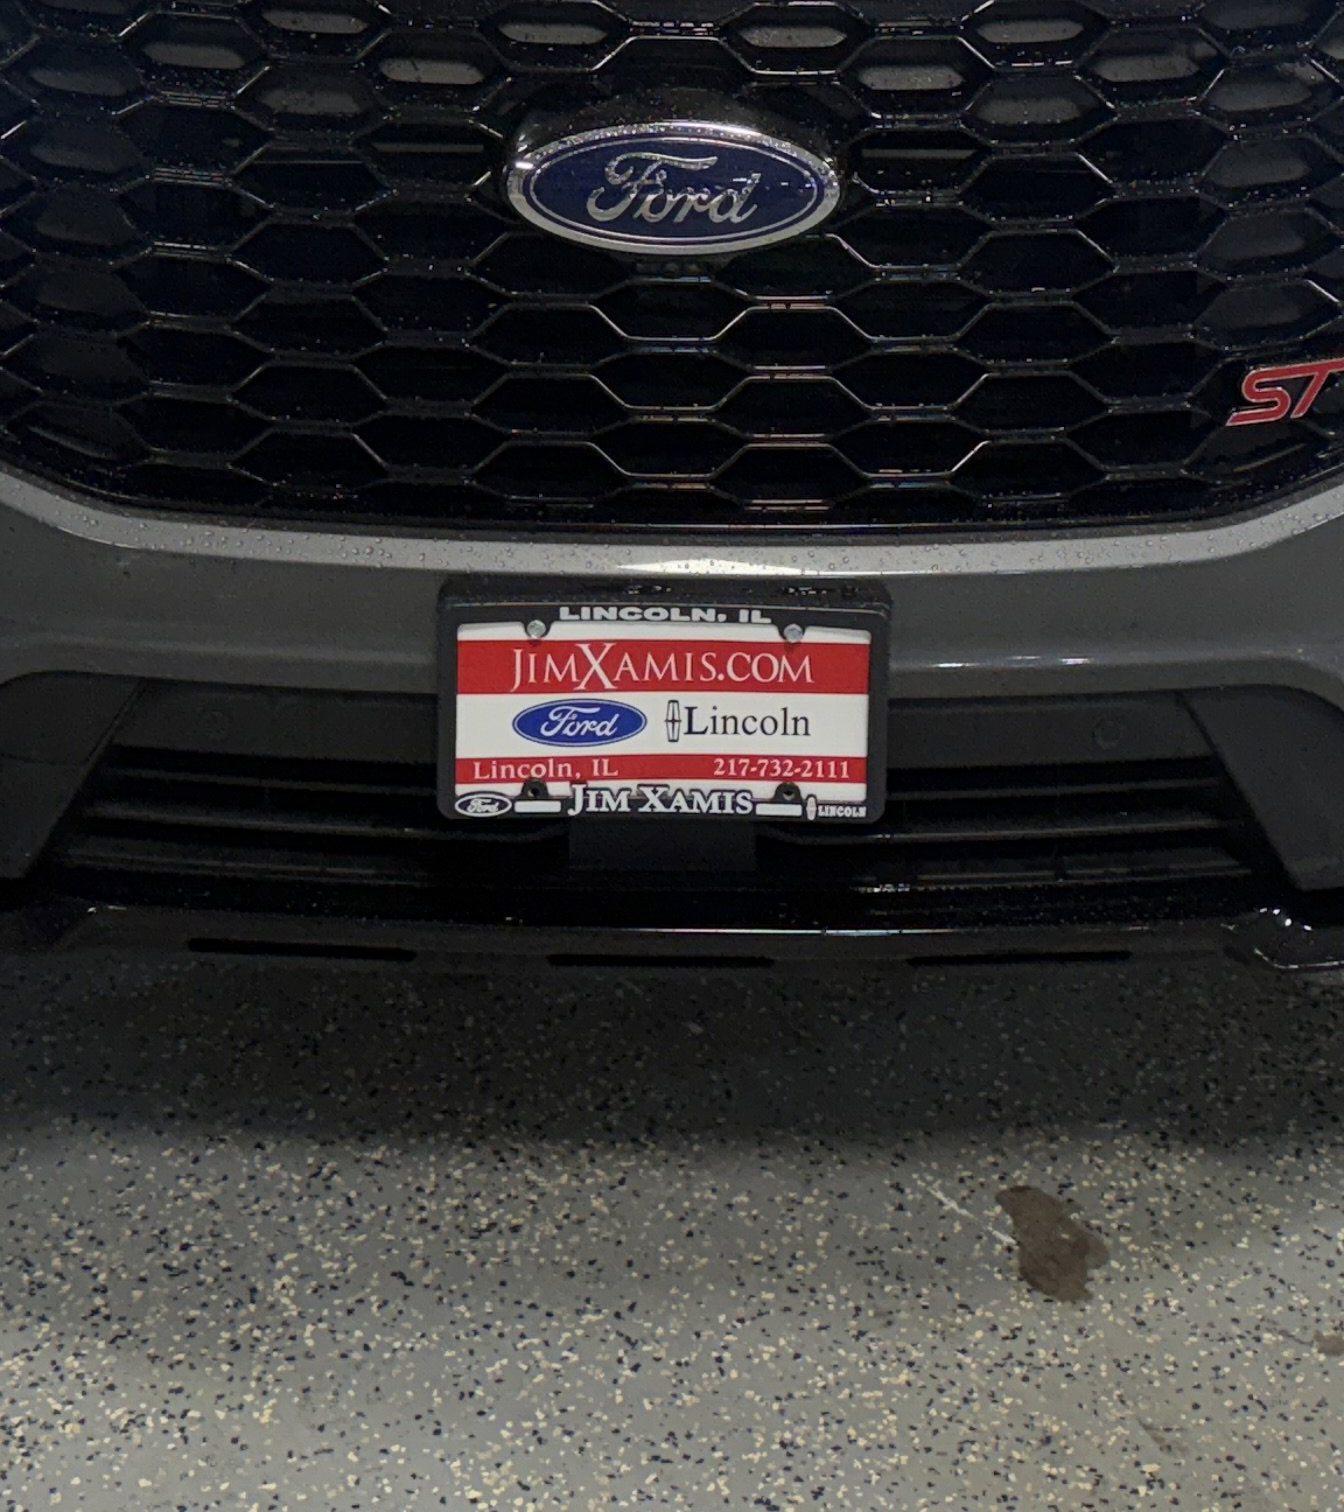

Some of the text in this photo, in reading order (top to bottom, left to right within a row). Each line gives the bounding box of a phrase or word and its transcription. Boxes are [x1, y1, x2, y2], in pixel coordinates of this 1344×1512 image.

[586, 152, 762, 224] Ford
[738, 608, 772, 624] IL
[539, 704, 811, 739] Ford Lincoln
[473, 758, 850, 780] Lincoln, IL 217-732-2111
[818, 805, 867, 818] LINCOLN
